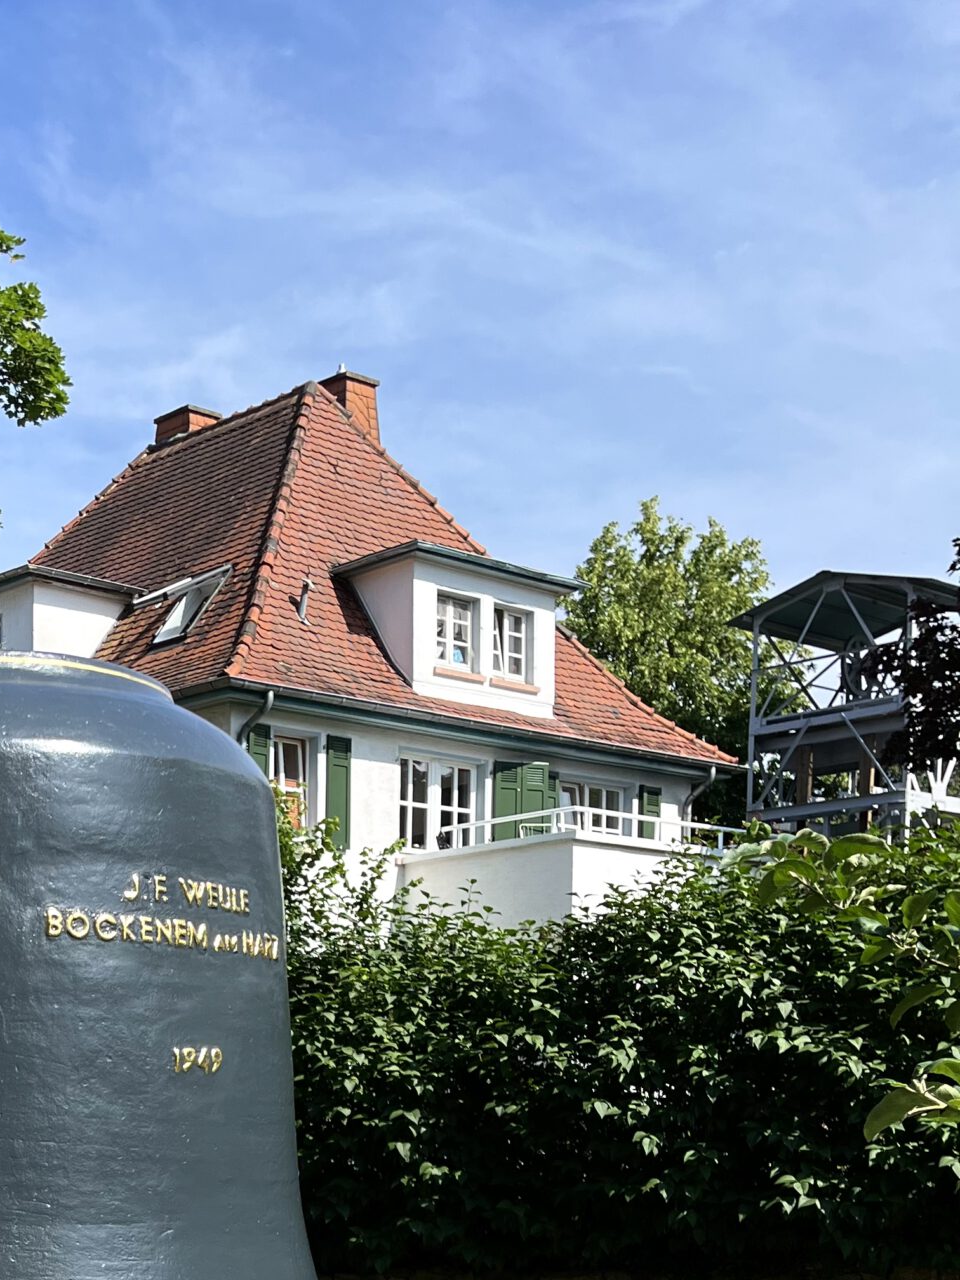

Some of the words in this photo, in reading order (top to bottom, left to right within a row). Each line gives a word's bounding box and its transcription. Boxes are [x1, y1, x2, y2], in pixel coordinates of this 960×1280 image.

[178, 877, 250, 913] WEULE
[46, 906, 208, 949] BOCKENEM
[172, 1046, 223, 1074] 1949
